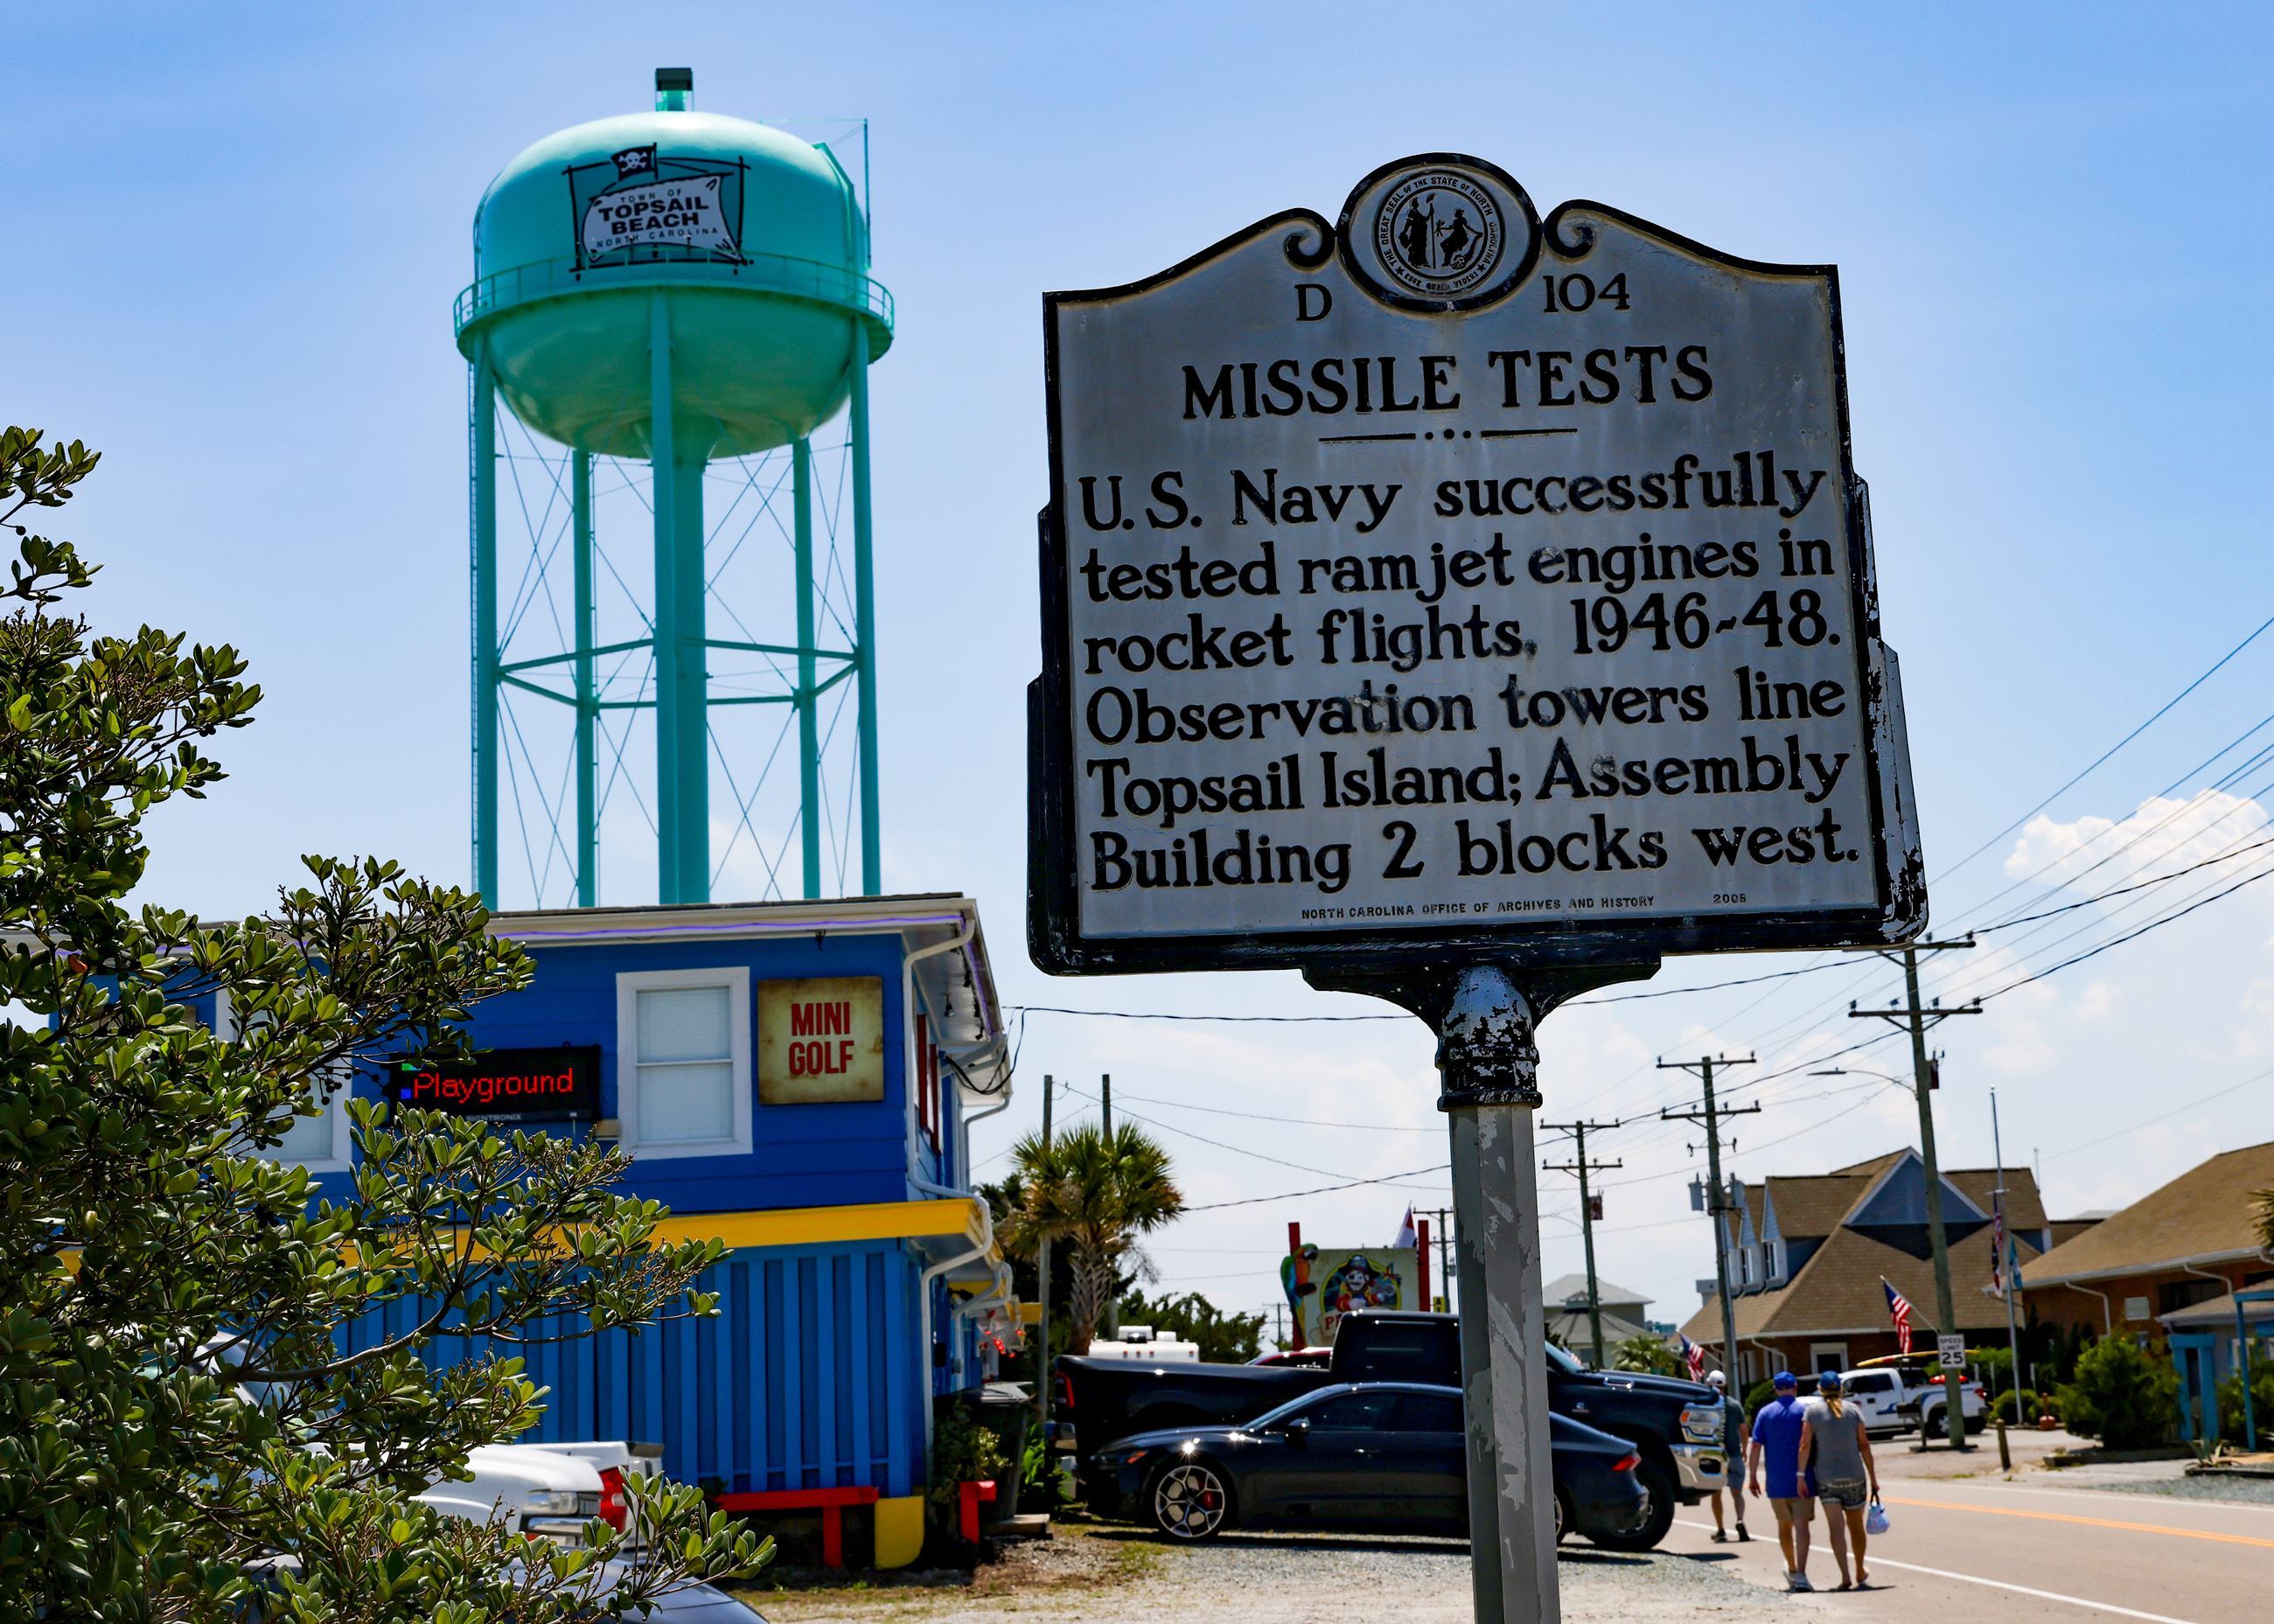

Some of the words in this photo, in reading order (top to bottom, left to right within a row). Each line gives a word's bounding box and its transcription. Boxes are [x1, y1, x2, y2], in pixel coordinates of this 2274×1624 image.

[1404, 185, 1412, 193] OF
[1413, 179, 1427, 188] THE
[1431, 177, 1459, 187] STATE
[598, 197, 709, 221] TOPSAIL
[621, 193, 655, 203] TOWN
[1387, 193, 1404, 213] SEAL
[1470, 189, 1493, 215] NORTH
[597, 234, 638, 247] NORTH
[649, 227, 717, 240] CAROLINA
[612, 213, 699, 235] BEACH
[1380, 216, 1390, 245] GREAT
[1384, 248, 1397, 267] THE
[1454, 272, 1478, 287] VIDERI
[1294, 283, 1333, 322] D
[1544, 272, 1630, 313] 104
[1182, 355, 1461, 420] MISSILE
[1489, 345, 1712, 408] TESTS
[1230, 468, 1402, 533] Navy
[1434, 450, 1826, 518] successfully
[1080, 540, 1280, 602] tested
[1299, 542, 1515, 603] ramjet
[1528, 533, 1759, 593] engines
[1778, 528, 1834, 576] in
[1084, 612, 1294, 674] rocket
[1086, 680, 1476, 745] Observation
[1498, 673, 1709, 728] towers
[1733, 666, 1845, 721] line
[1087, 748, 1305, 828] Topsail
[1320, 746, 1522, 806] Island;
[1536, 735, 1850, 803] Assembly
[1091, 827, 1351, 894] Building
[1382, 820, 1425, 879] 2
[1454, 813, 1667, 875] blocks
[1692, 807, 1859, 868] west.
[1301, 909, 1344, 918] NORTH
[1349, 905, 1414, 917] CAROLINA
[1422, 903, 1467, 914] OFFICE
[1474, 903, 1489, 912] OF
[1497, 900, 1561, 912] ARCHIVES
[1568, 897, 1594, 909] AND
[1601, 896, 1655, 908] HISTORY
[792, 1001, 850, 1036] MINI
[789, 1041, 854, 1076] GOLF
[414, 1068, 573, 1104] Playground
[1942, 1352, 1963, 1364] 25
